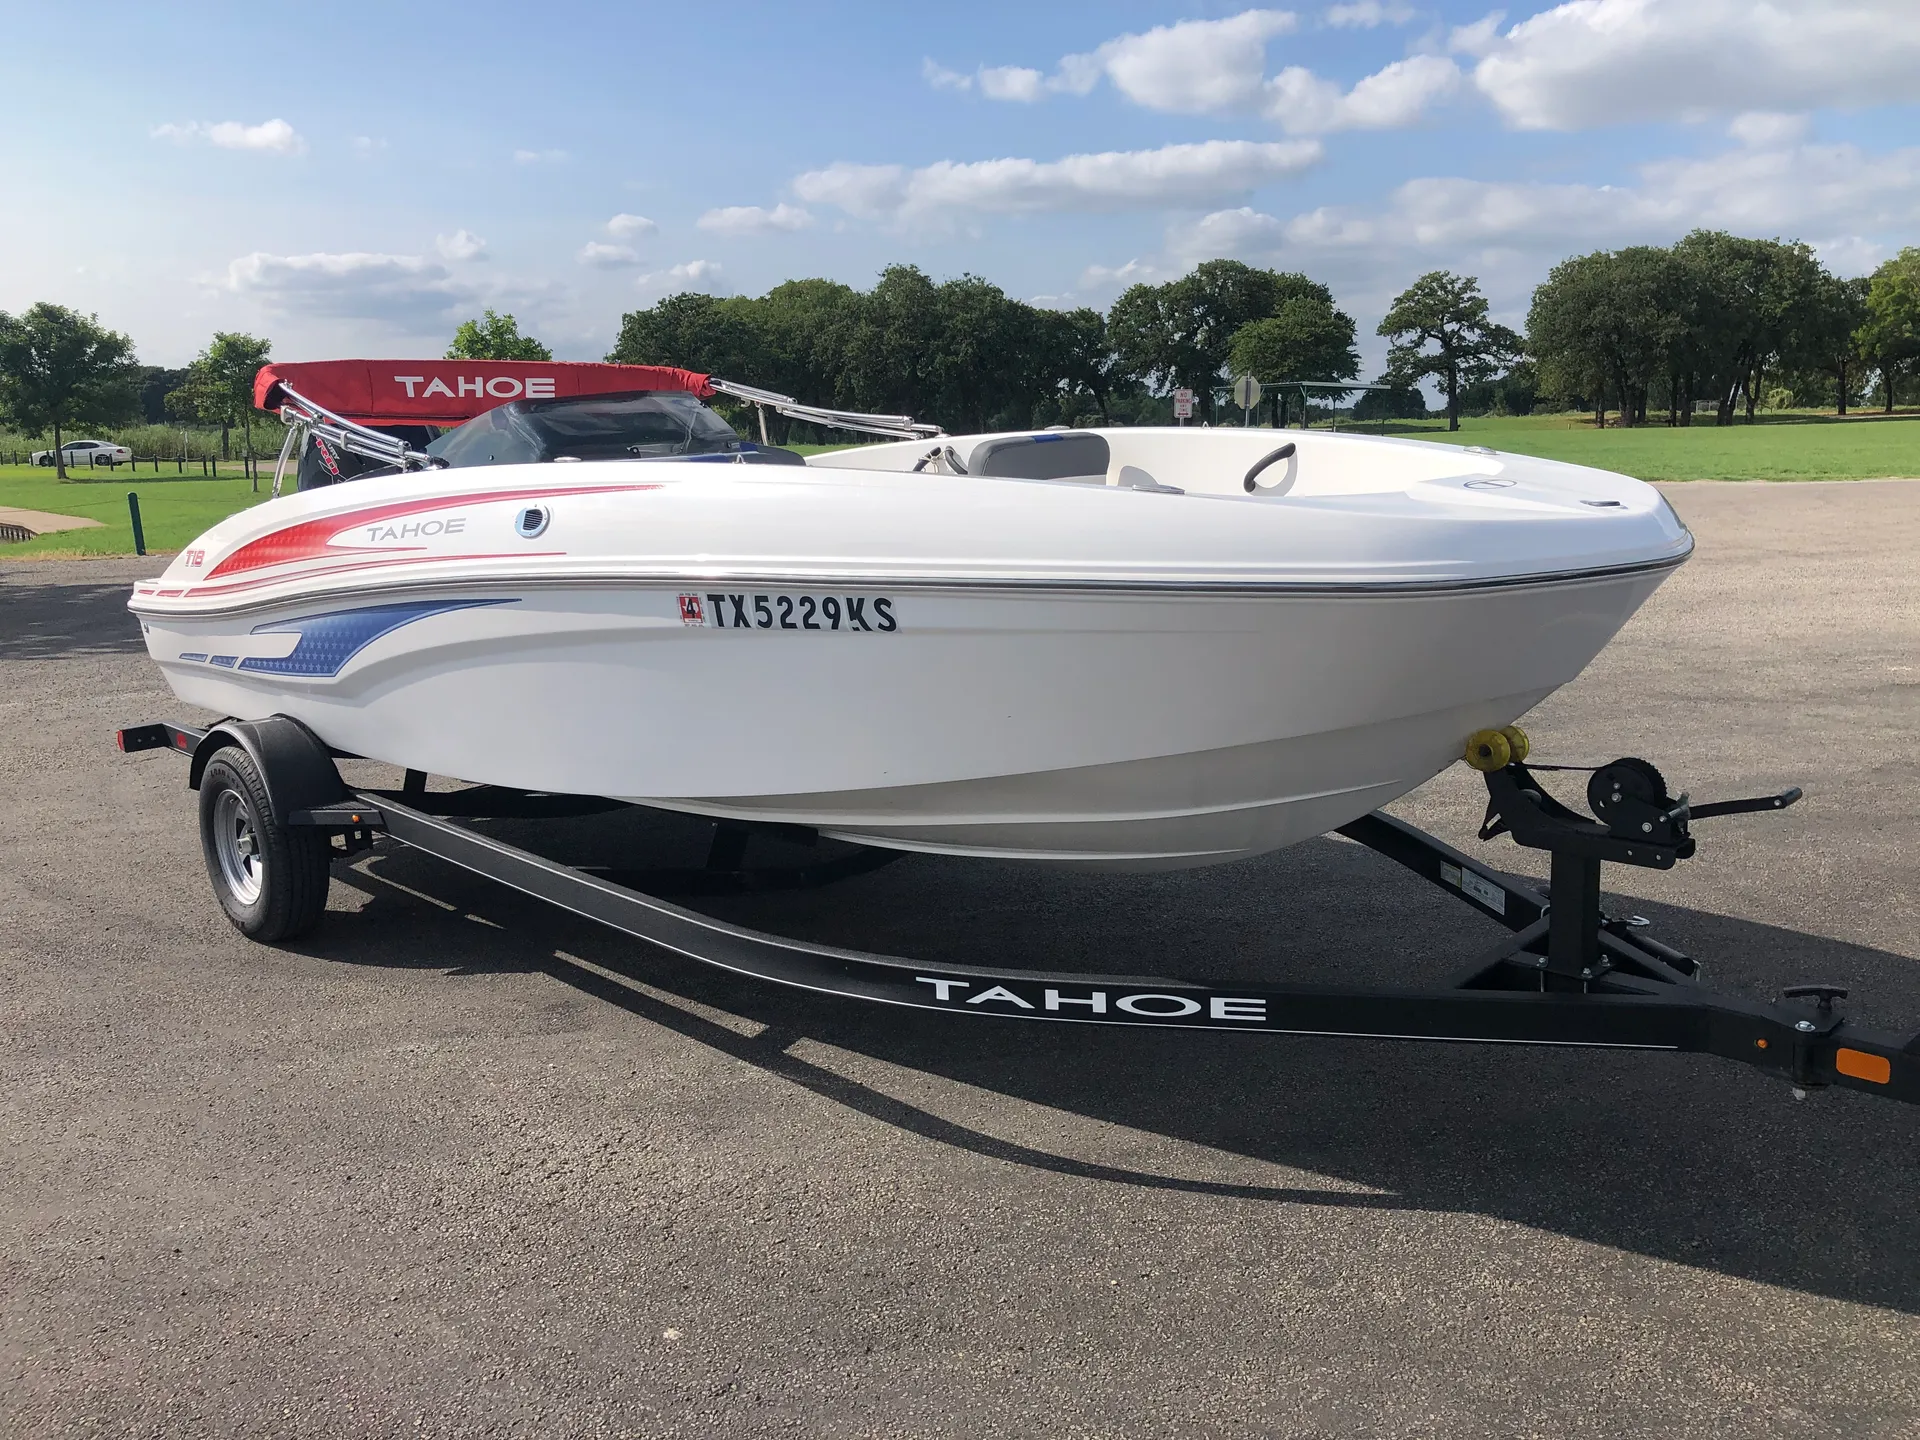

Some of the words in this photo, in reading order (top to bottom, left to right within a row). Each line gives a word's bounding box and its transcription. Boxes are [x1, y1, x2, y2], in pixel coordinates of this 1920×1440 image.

[394, 375, 556, 399] TAHOE
[366, 517, 467, 542] TAHOE
[686, 597, 697, 619] 4
[915, 976, 1267, 1021] TAHOE
